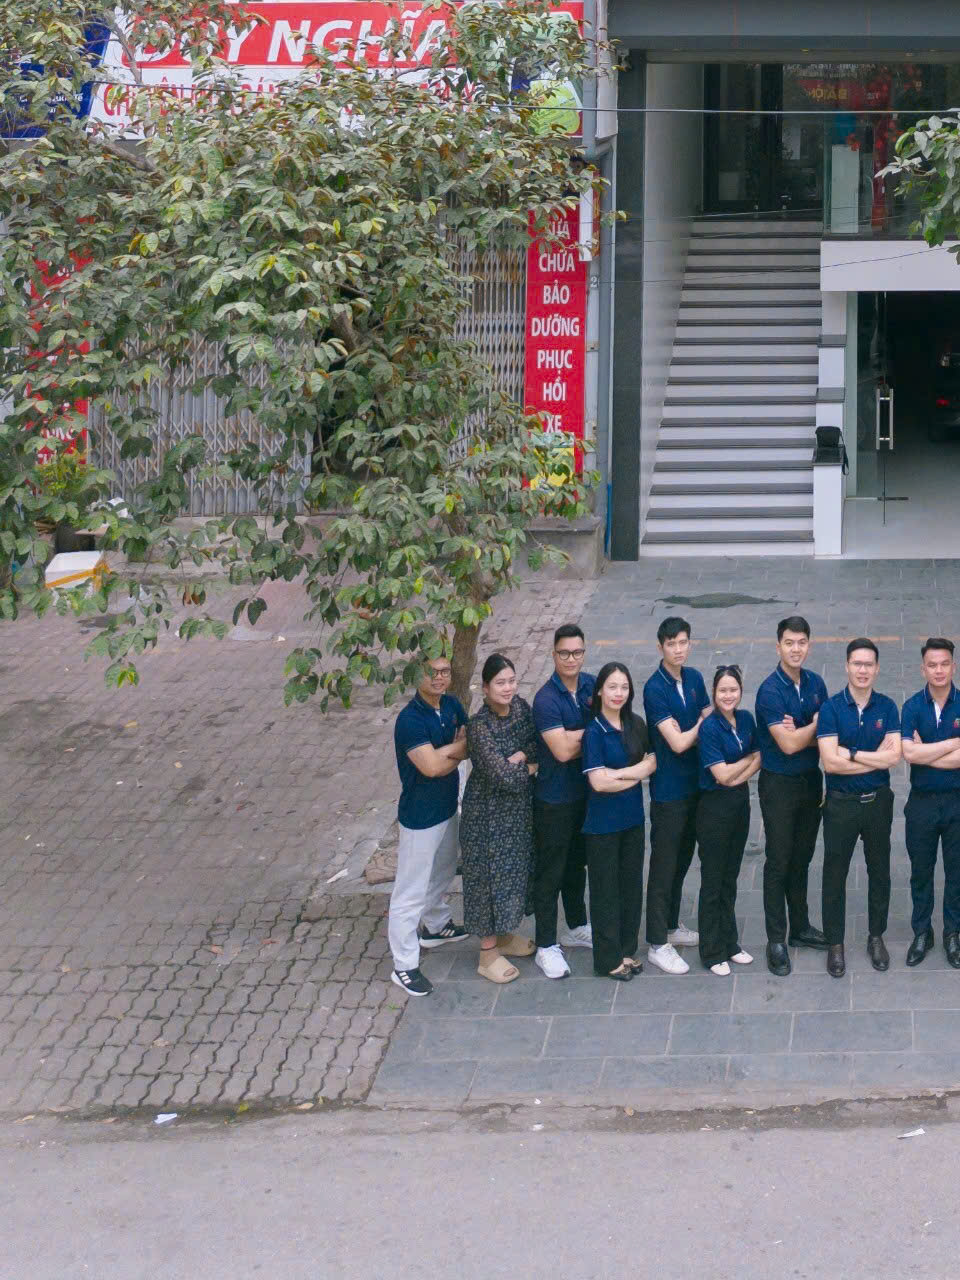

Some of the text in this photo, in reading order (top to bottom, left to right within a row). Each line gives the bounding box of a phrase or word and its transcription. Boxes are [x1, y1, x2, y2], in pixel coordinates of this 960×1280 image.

[543, 279, 570, 305] BẢO
[531, 313, 580, 337] DƯỠNG
[536, 349, 573, 374] PHỤC
[543, 377, 566, 401] HỒI
[545, 414, 562, 433] XE
